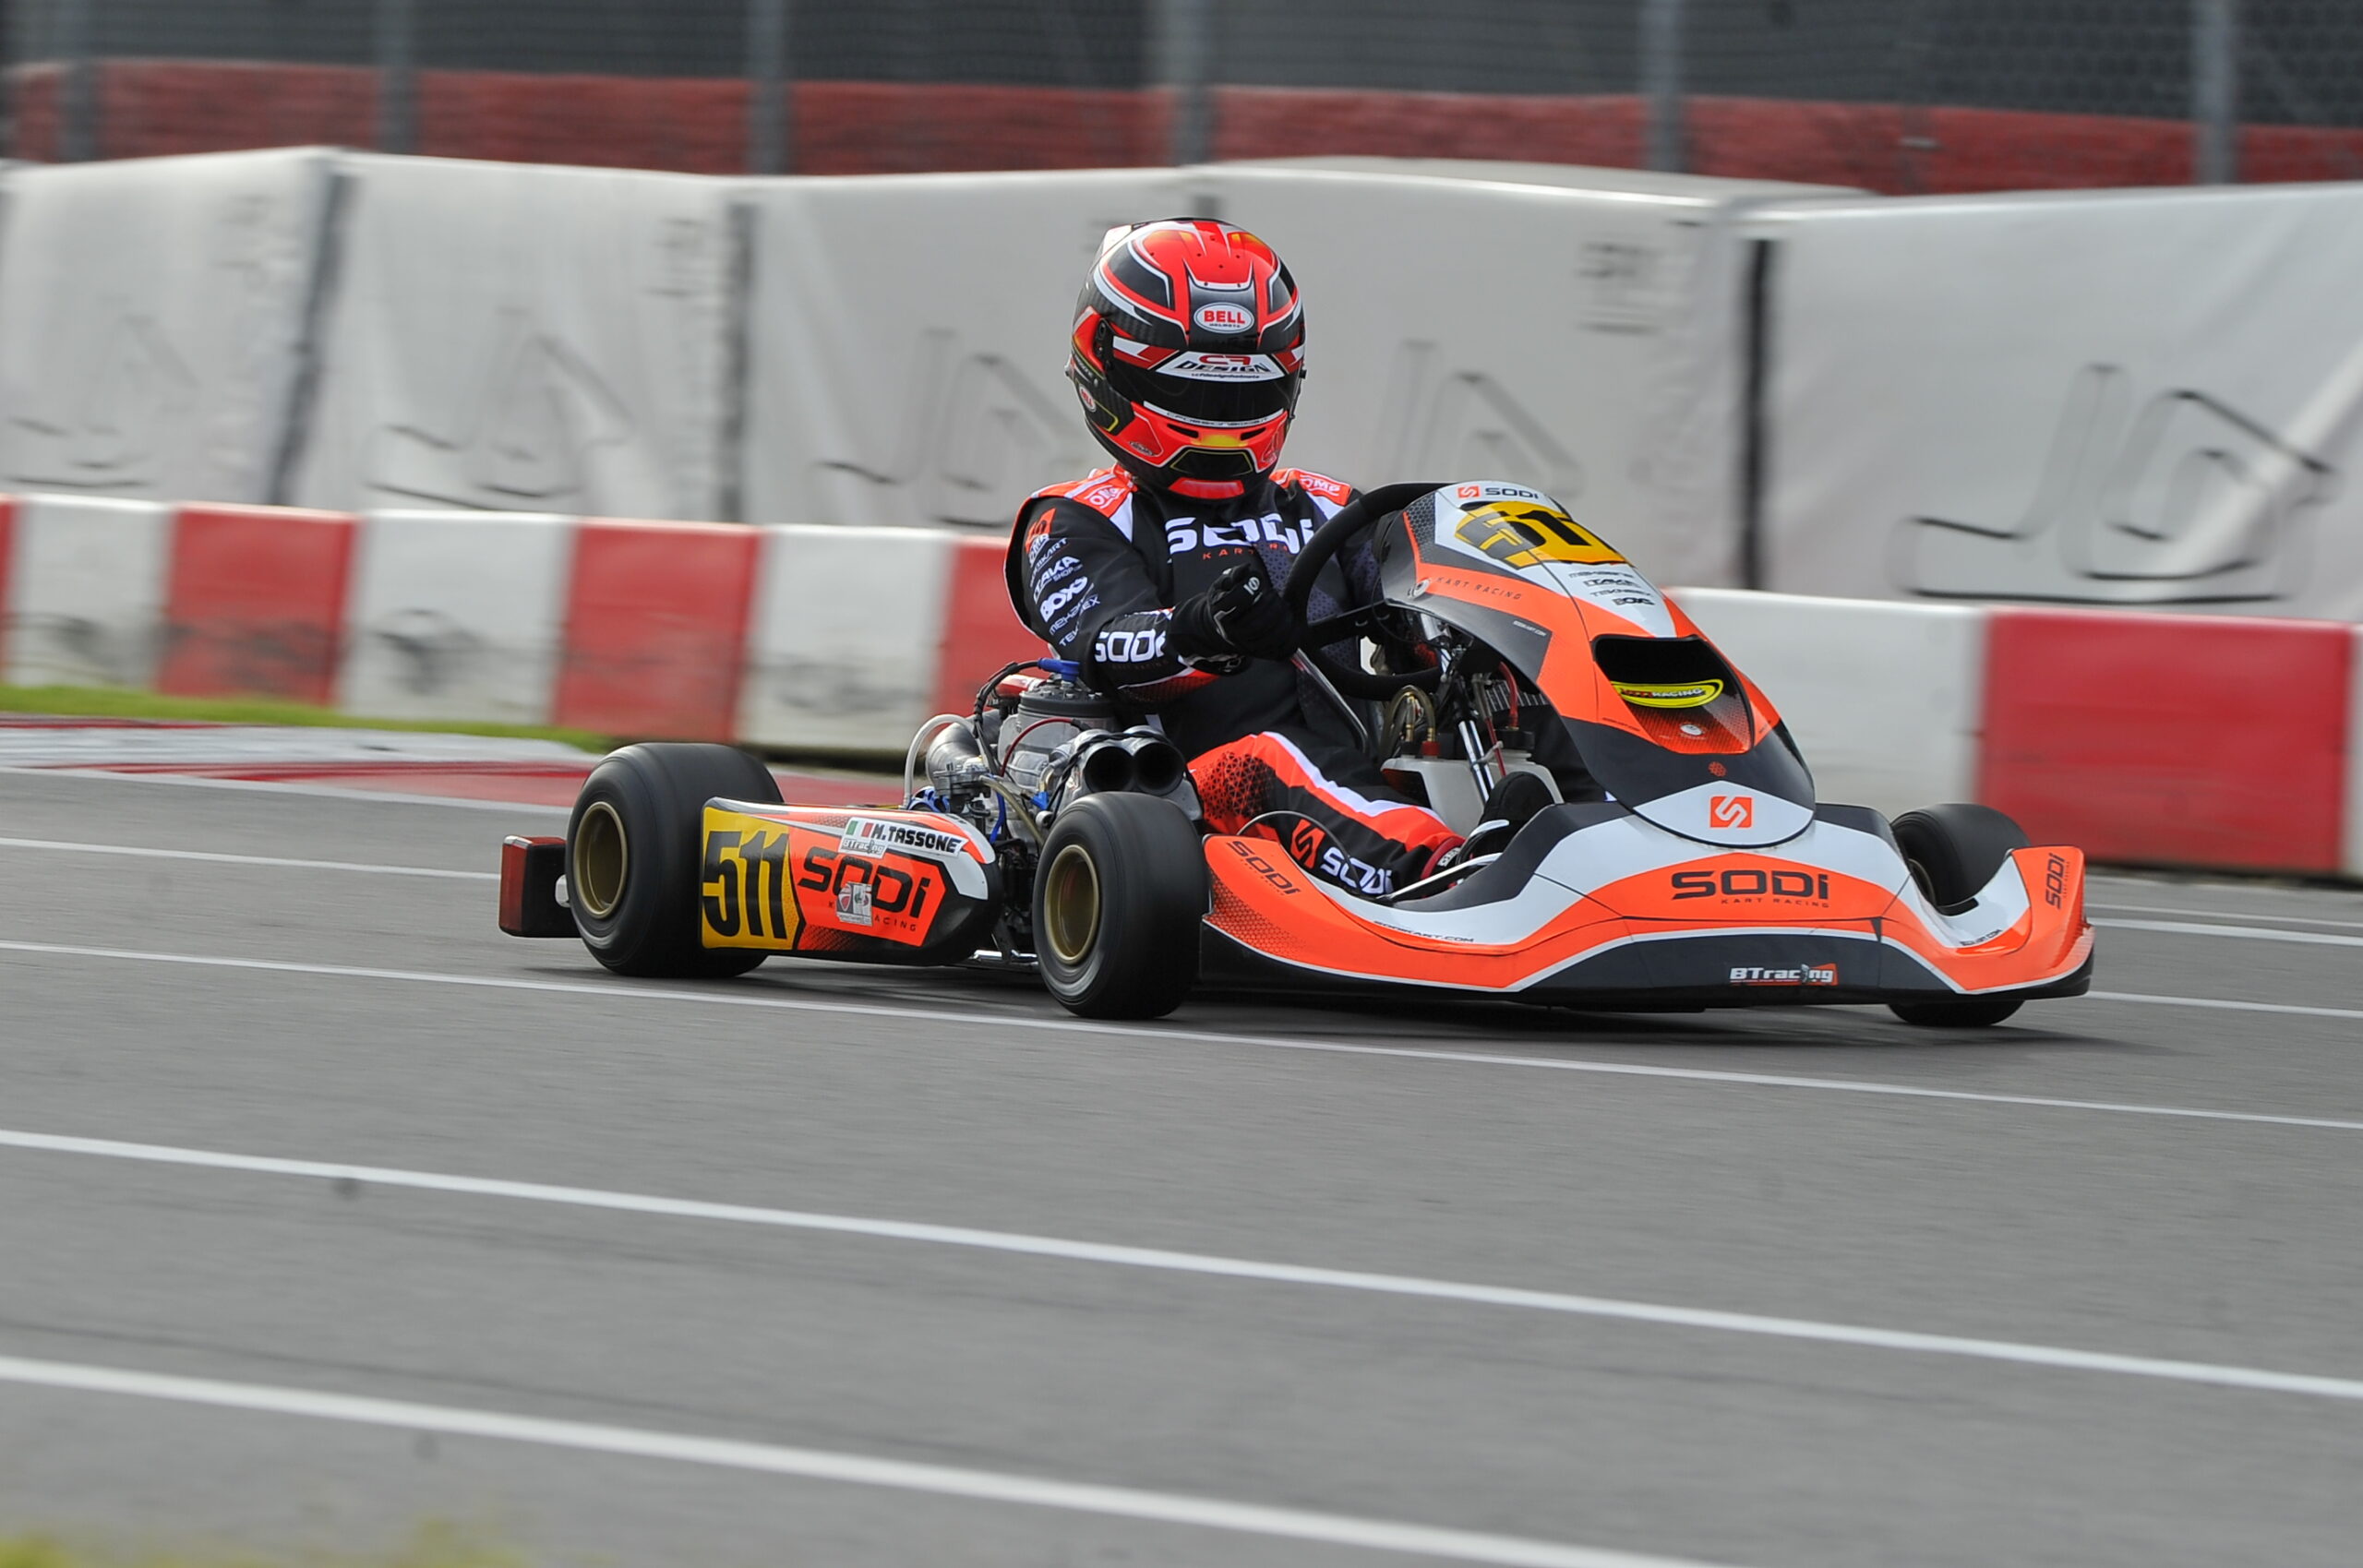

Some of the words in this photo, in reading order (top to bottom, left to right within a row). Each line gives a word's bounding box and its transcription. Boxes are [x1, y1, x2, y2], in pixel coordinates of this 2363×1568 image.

[1204, 310, 1246, 324] BELL
[1175, 360, 1272, 373] DESIGN
[1475, 584, 1522, 600] RACING
[871, 823, 963, 854] M.TASSONE
[702, 830, 790, 940] 511
[1773, 898, 1829, 908] RACING
[874, 914, 917, 932] ACING
